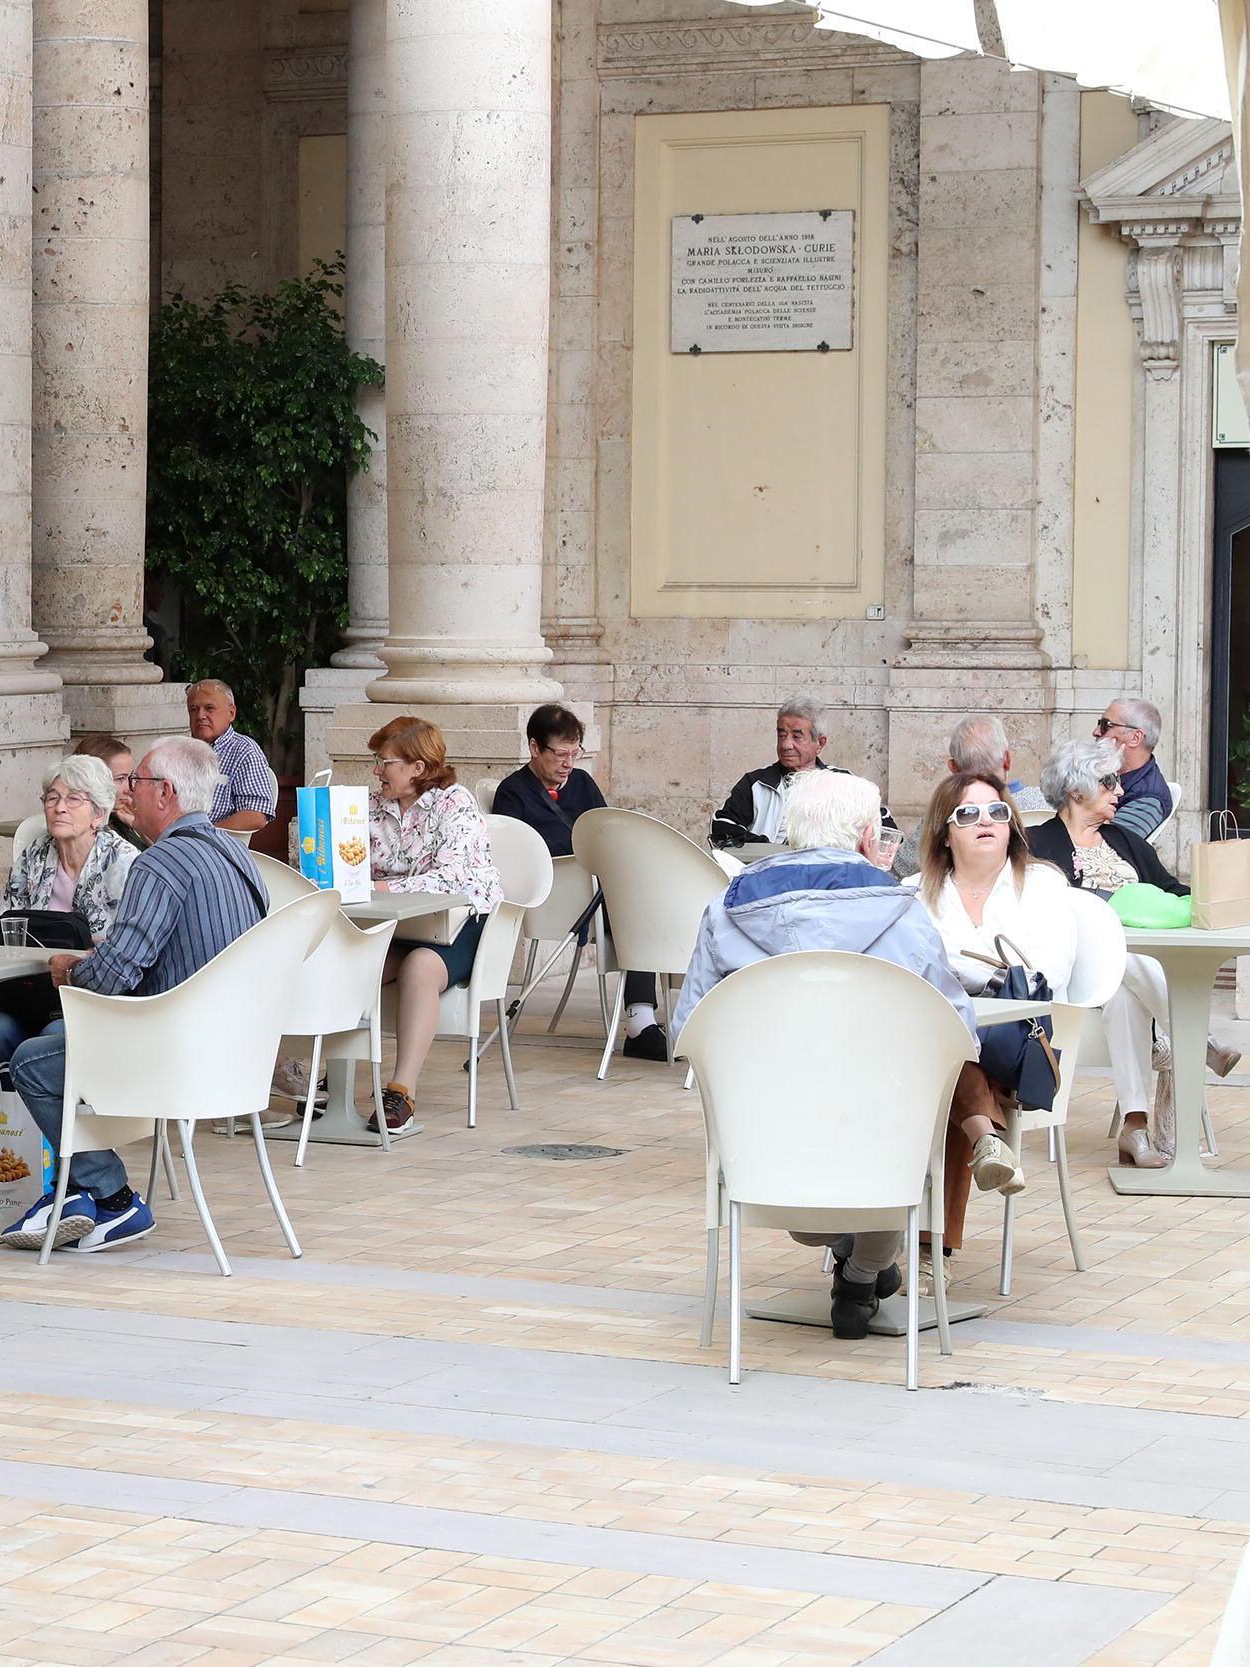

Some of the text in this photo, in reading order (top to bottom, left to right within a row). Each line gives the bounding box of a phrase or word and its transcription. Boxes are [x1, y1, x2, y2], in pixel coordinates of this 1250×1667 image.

[687, 247, 720, 256] MARIA
[804, 243, 836, 253] CURIE
[776, 275, 817, 283] RAFFAELLO
[790, 284, 804, 292] DEL
[5, 1198, 22, 1207] Pane
